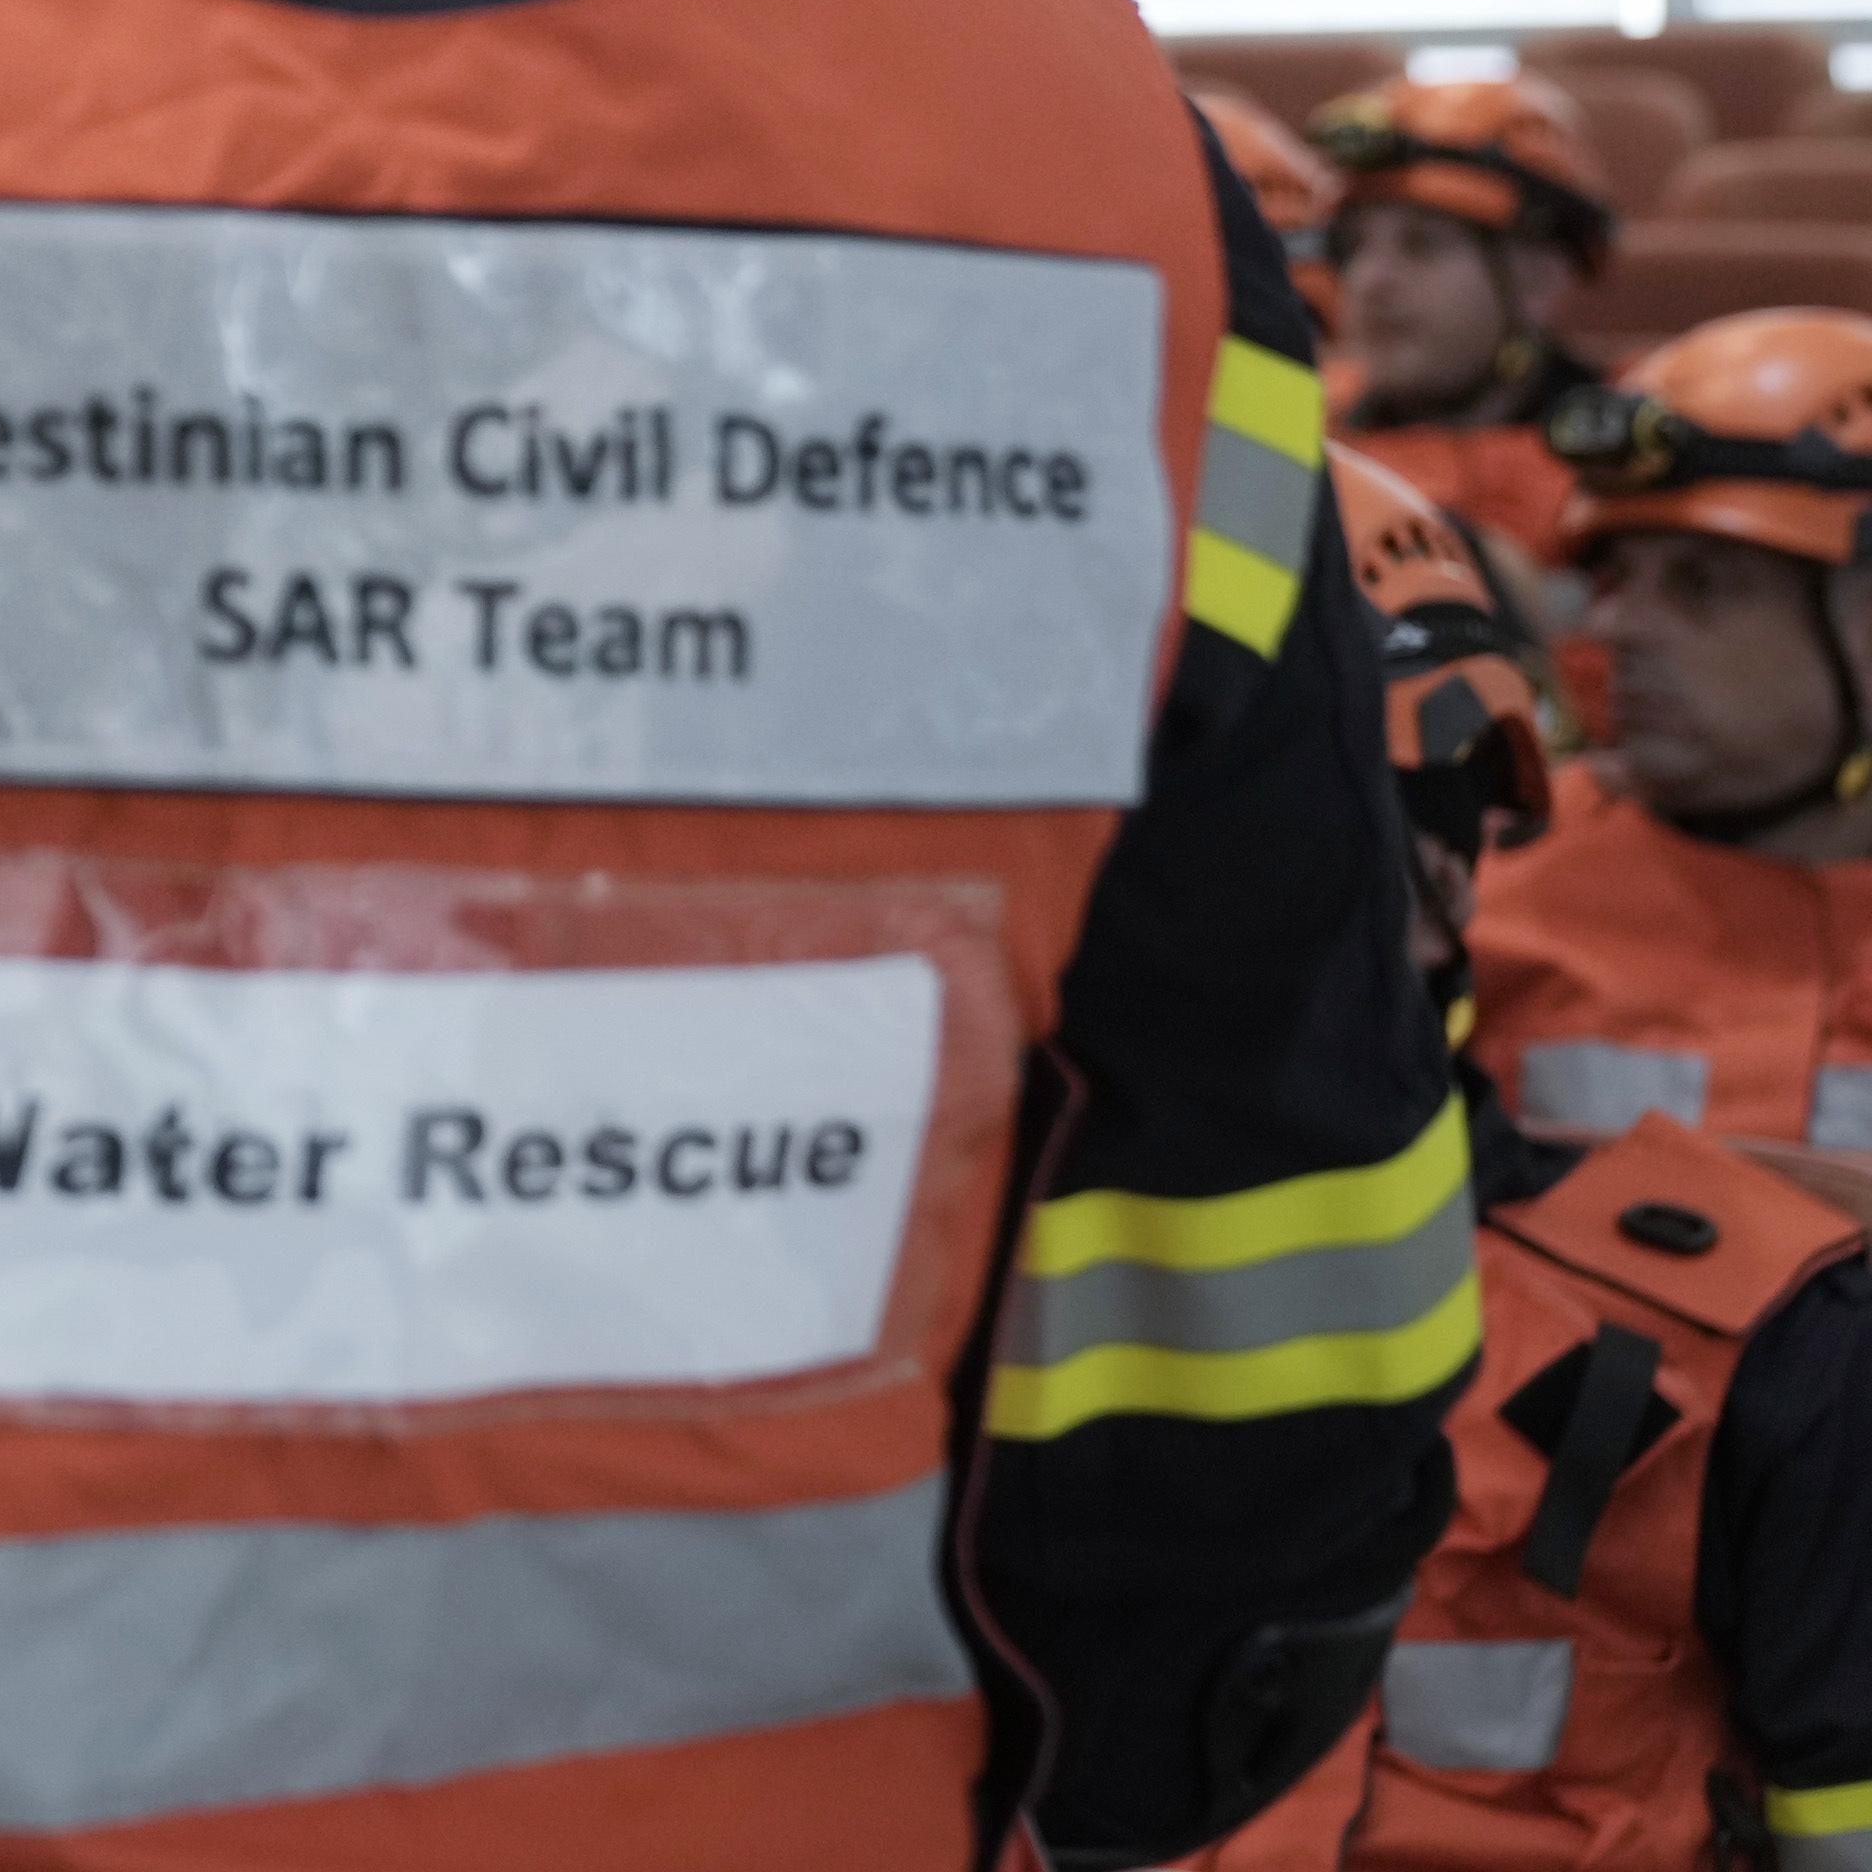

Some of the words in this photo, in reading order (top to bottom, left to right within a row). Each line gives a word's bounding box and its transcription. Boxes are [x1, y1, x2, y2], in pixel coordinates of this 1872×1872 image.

[444, 400, 676, 508] Civil
[711, 410, 1090, 524] Defence
[194, 568, 418, 668] SAR
[454, 580, 750, 680] Team
[398, 1104, 866, 1204] Rescue
